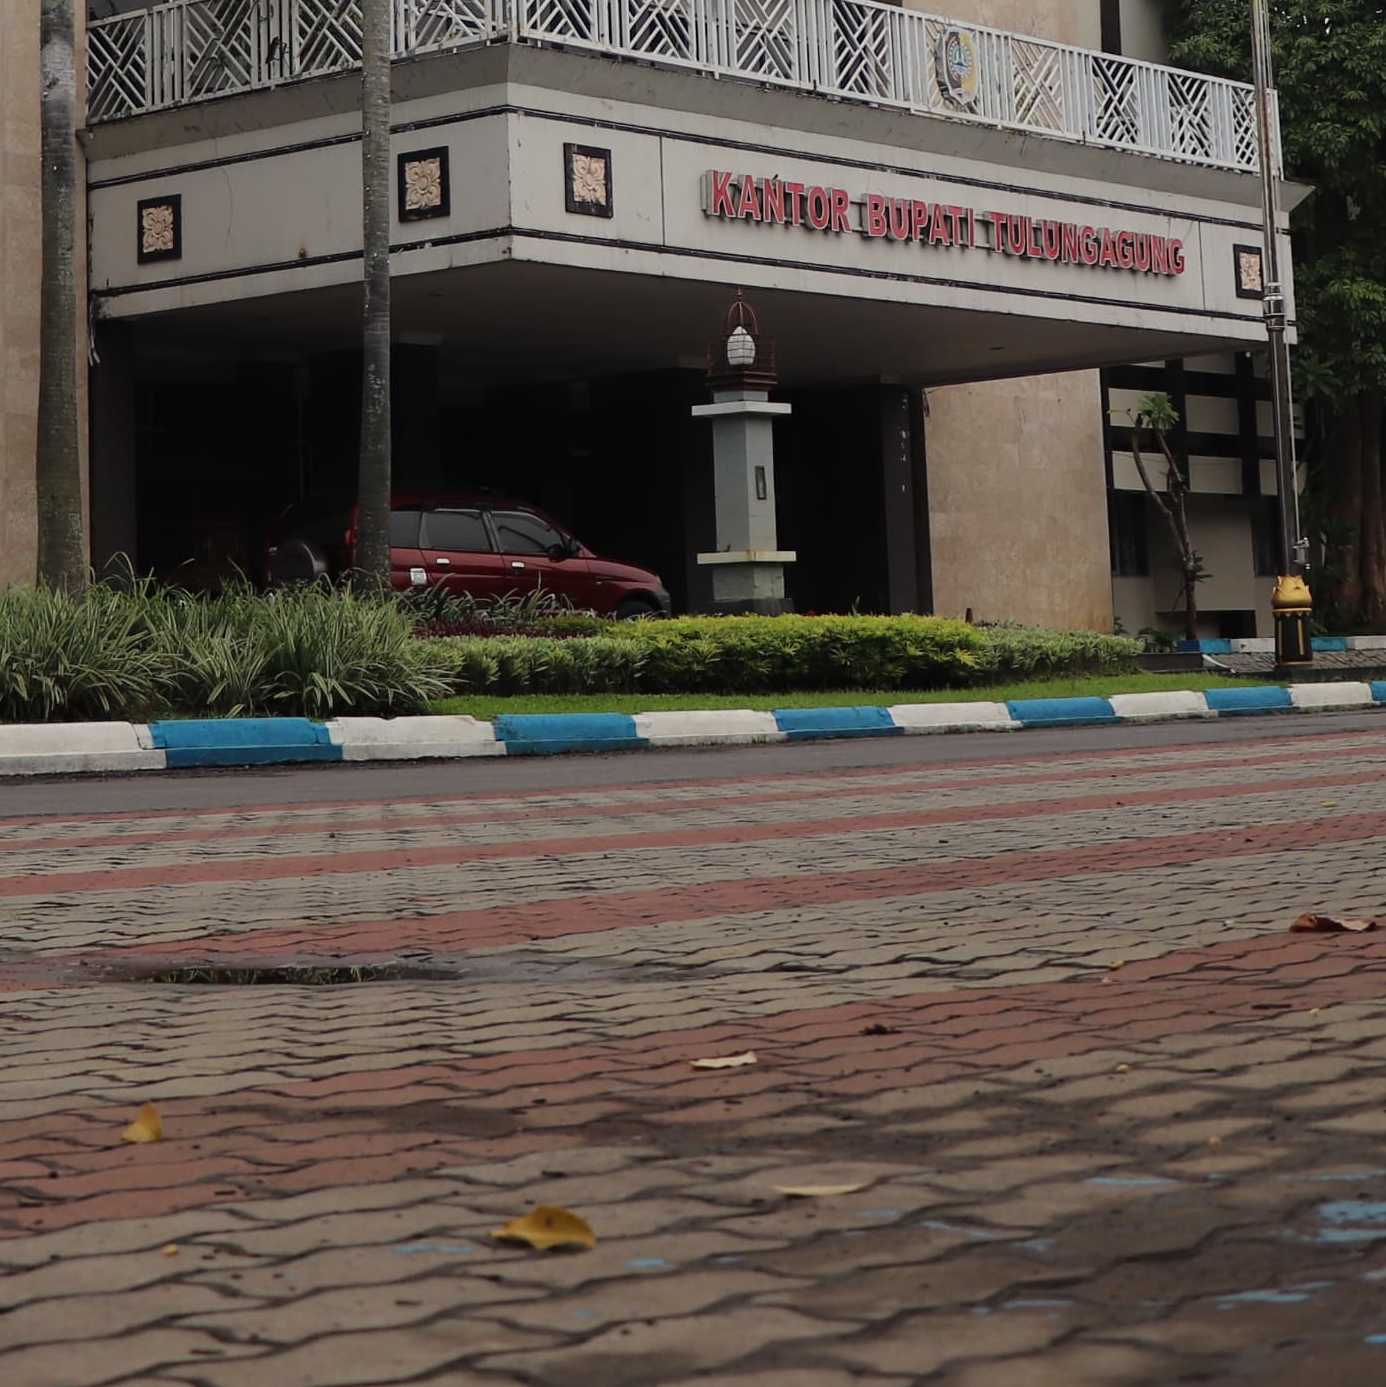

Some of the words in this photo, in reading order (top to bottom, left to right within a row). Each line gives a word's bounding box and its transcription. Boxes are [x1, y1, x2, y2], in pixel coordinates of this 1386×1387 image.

[710, 170, 852, 233] KANTOR
[866, 194, 975, 249] BUPATI
[988, 211, 1186, 276] TULUNGAGUNG
